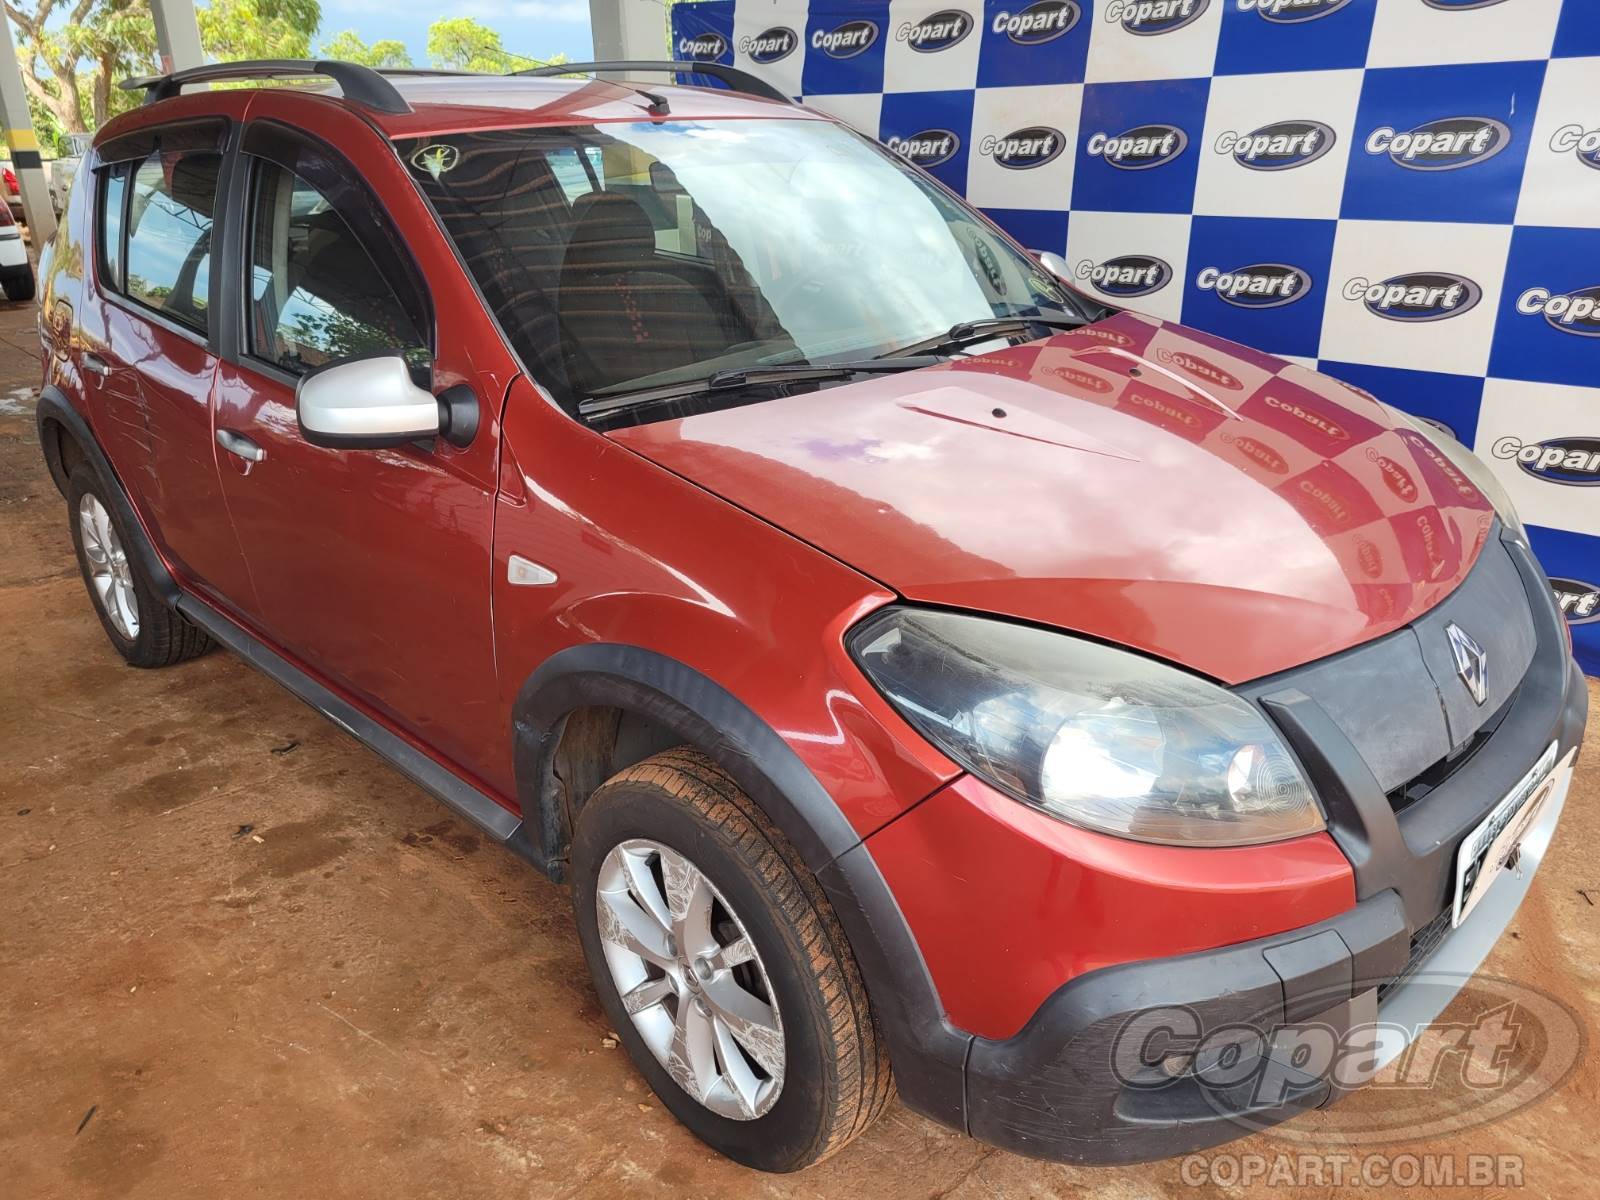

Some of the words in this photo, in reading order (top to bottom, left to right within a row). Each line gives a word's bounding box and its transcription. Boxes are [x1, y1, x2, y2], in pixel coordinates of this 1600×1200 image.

[992, 2, 1069, 37] Copart
[1105, 0, 1191, 27] Copart
[812, 26, 873, 51] Copart
[896, 15, 965, 46] Copart
[680, 37, 721, 54] Copart
[739, 33, 790, 57] Copart
[888, 133, 951, 159] Copart
[979, 131, 1056, 158] Copart
[1087, 128, 1177, 160] Copart
[1214, 128, 1320, 160] Copart
[1365, 123, 1496, 160] Copart
[1075, 259, 1159, 286] Copart
[1196, 267, 1299, 297] Copart
[1342, 277, 1464, 309] Copart
